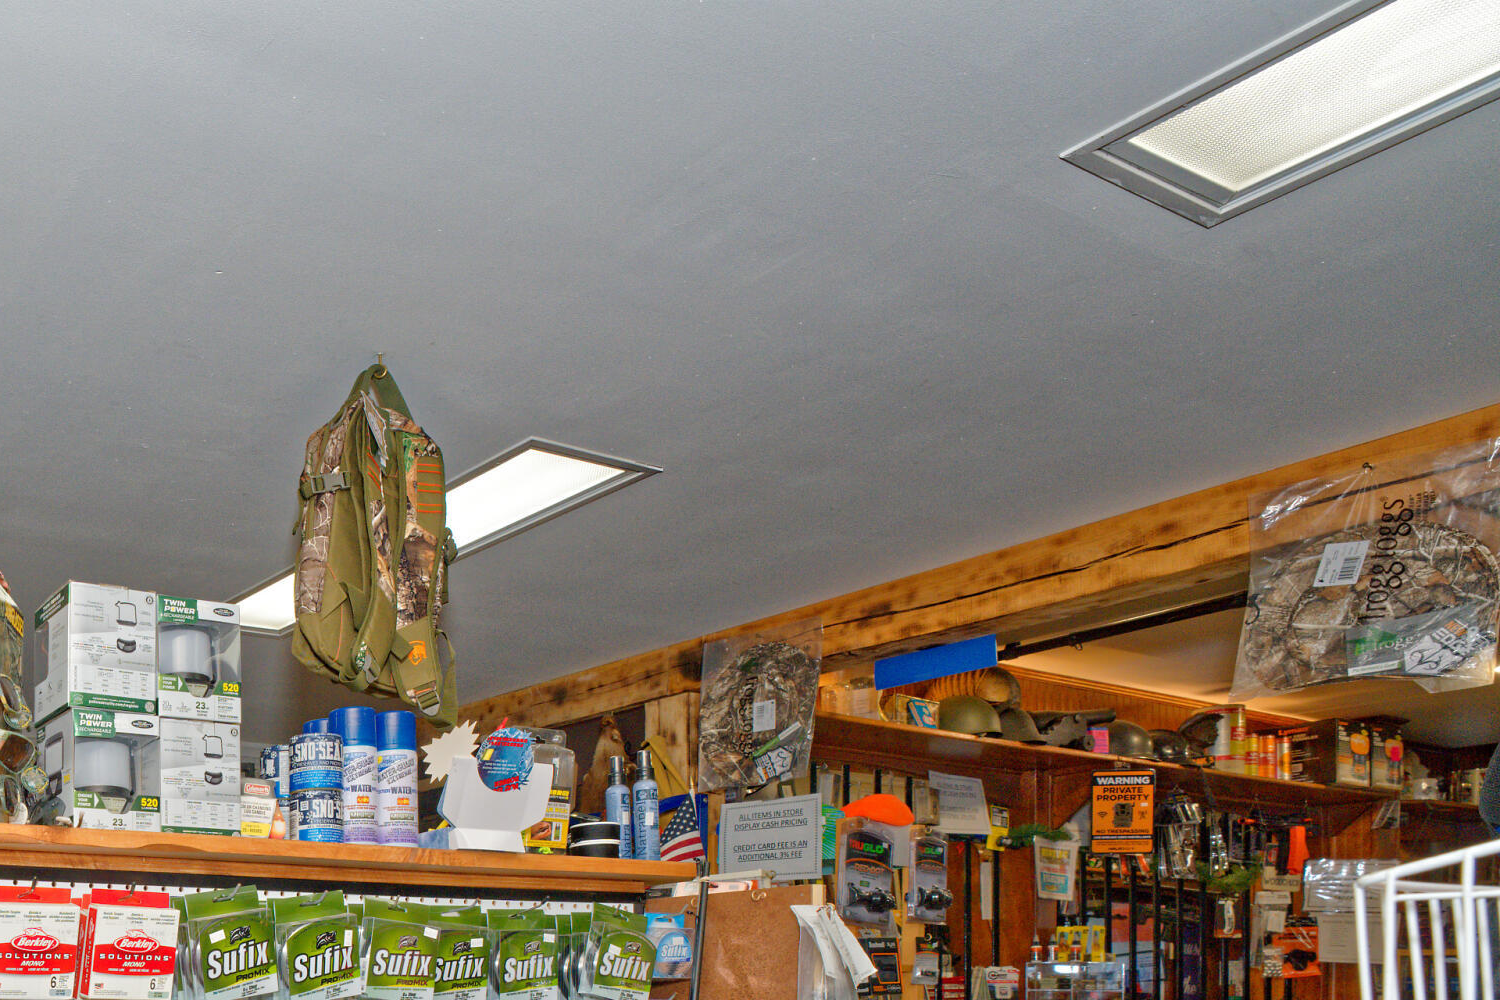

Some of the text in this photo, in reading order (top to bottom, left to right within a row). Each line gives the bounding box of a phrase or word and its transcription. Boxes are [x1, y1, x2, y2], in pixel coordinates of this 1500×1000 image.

[163, 598, 187, 608] TWIN
[164, 606, 196, 615] POWER
[222, 683, 239, 693] 520
[79, 712, 102, 721] TWIN
[79, 719, 113, 729] POWER
[1096, 776, 1150, 785] WARNING
[350, 784, 372, 793] WATER
[391, 786, 412, 795] WATER
[1102, 786, 1143, 794] PRIVATE
[140, 798, 158, 808] 520
[738, 813, 750, 821] ALL
[751, 811, 770, 820] ITEMS
[782, 808, 804, 817] STORE
[734, 818, 808, 832] DISPLAY CASH PRICING
[733, 839, 808, 852] CREDIT CARD FEE IS AN
[737, 850, 803, 862] ADDITIONAL 3% FEE
[16, 936, 58, 949] Berkley
[118, 938, 157, 951] Berkley
[100, 953, 170, 962] SOLUTIONS
[207, 939, 269, 981] Sufix
[293, 944, 353, 983] Sufix
[373, 949, 432, 979] Sufix
[504, 951, 555, 981] Sufix
[599, 951, 651, 982] Sufix
[50, 976, 57, 988] 6
[149, 977, 156, 990] 6
